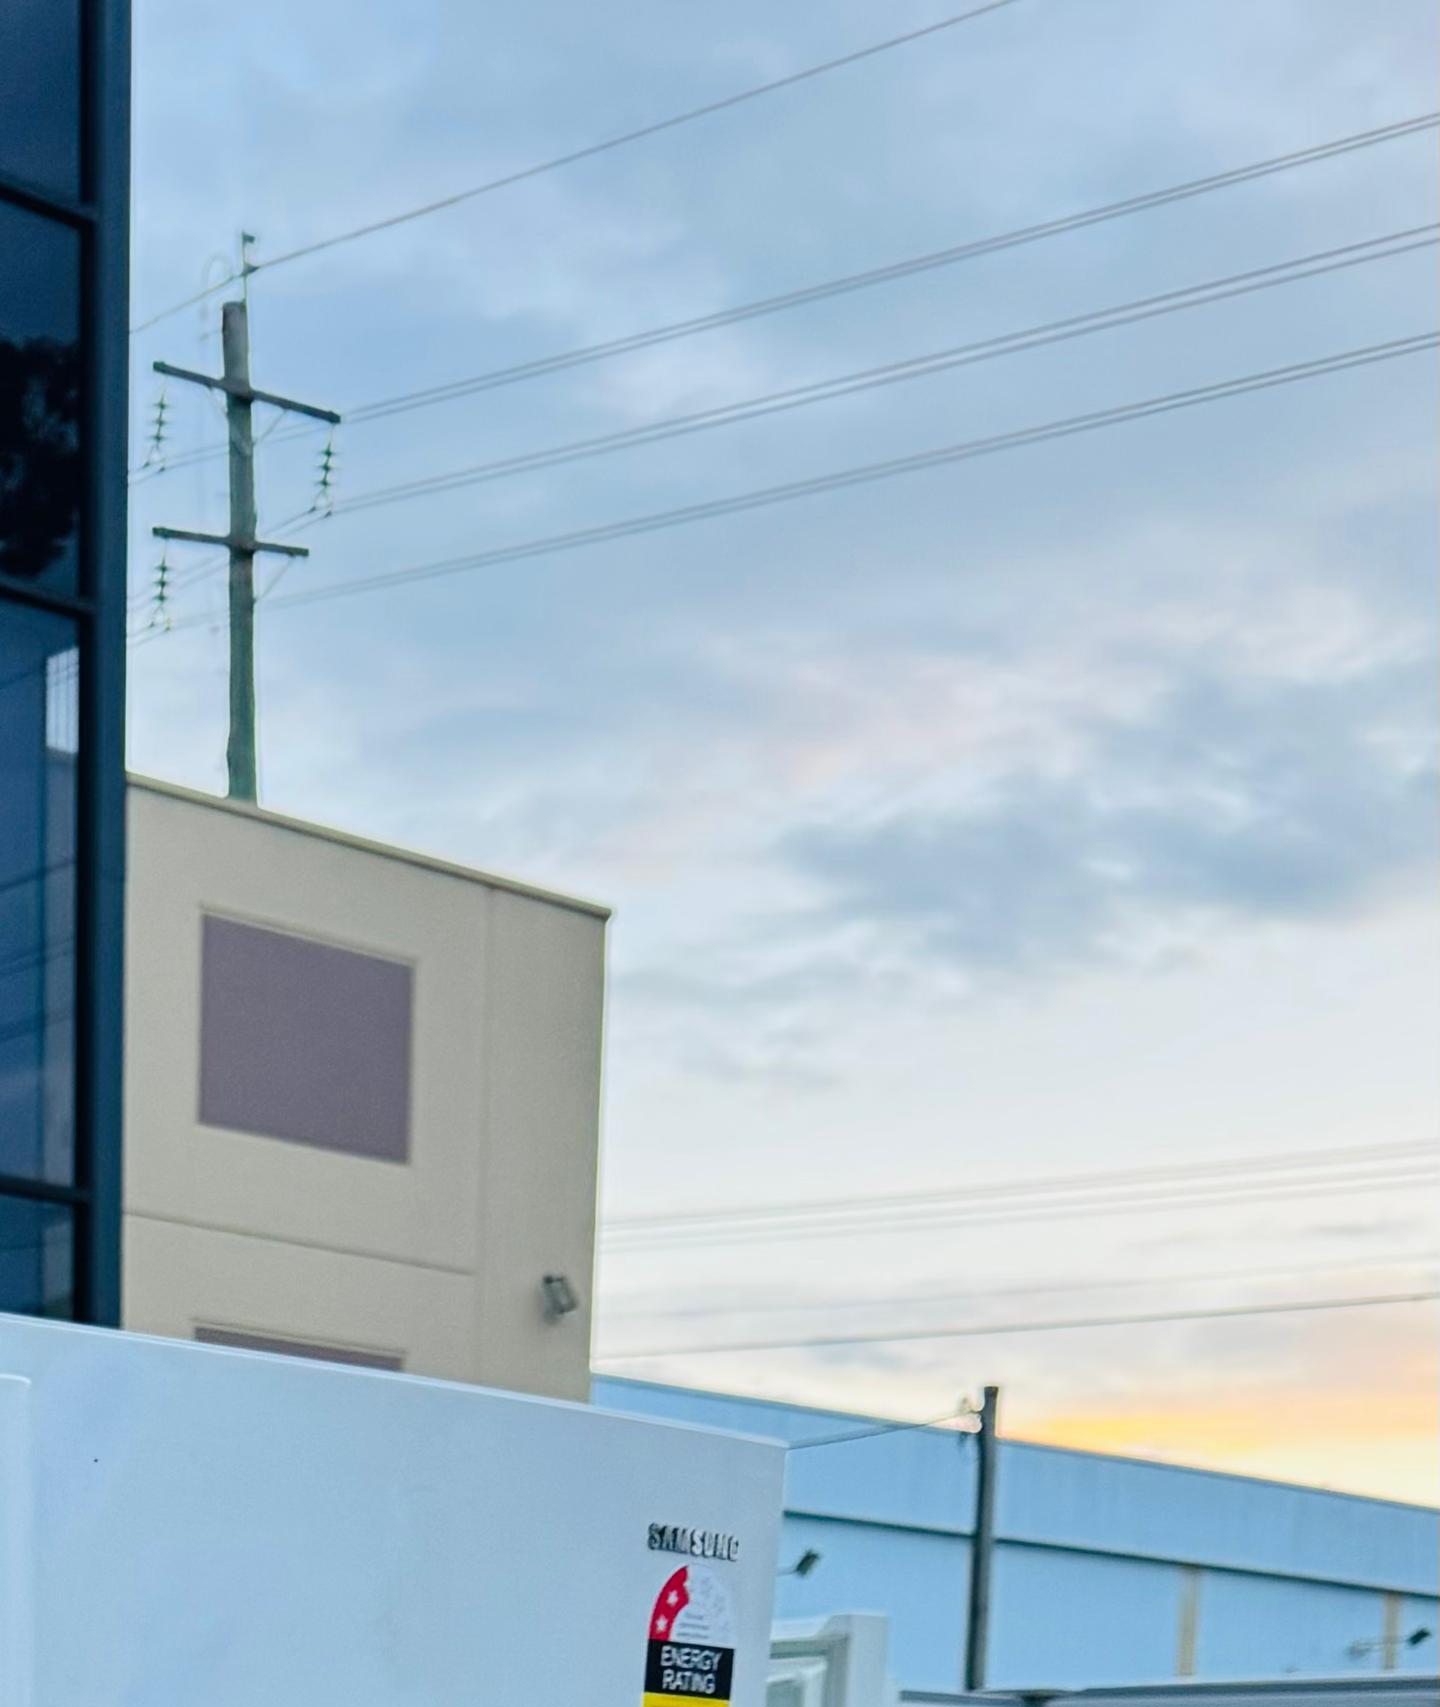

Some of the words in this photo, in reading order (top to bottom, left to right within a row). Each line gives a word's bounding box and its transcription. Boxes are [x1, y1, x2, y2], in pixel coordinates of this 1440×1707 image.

[647, 1522, 739, 1562] SAMSUNG
[661, 1645, 722, 1671] ENERGY
[662, 1669, 715, 1695] RATING
